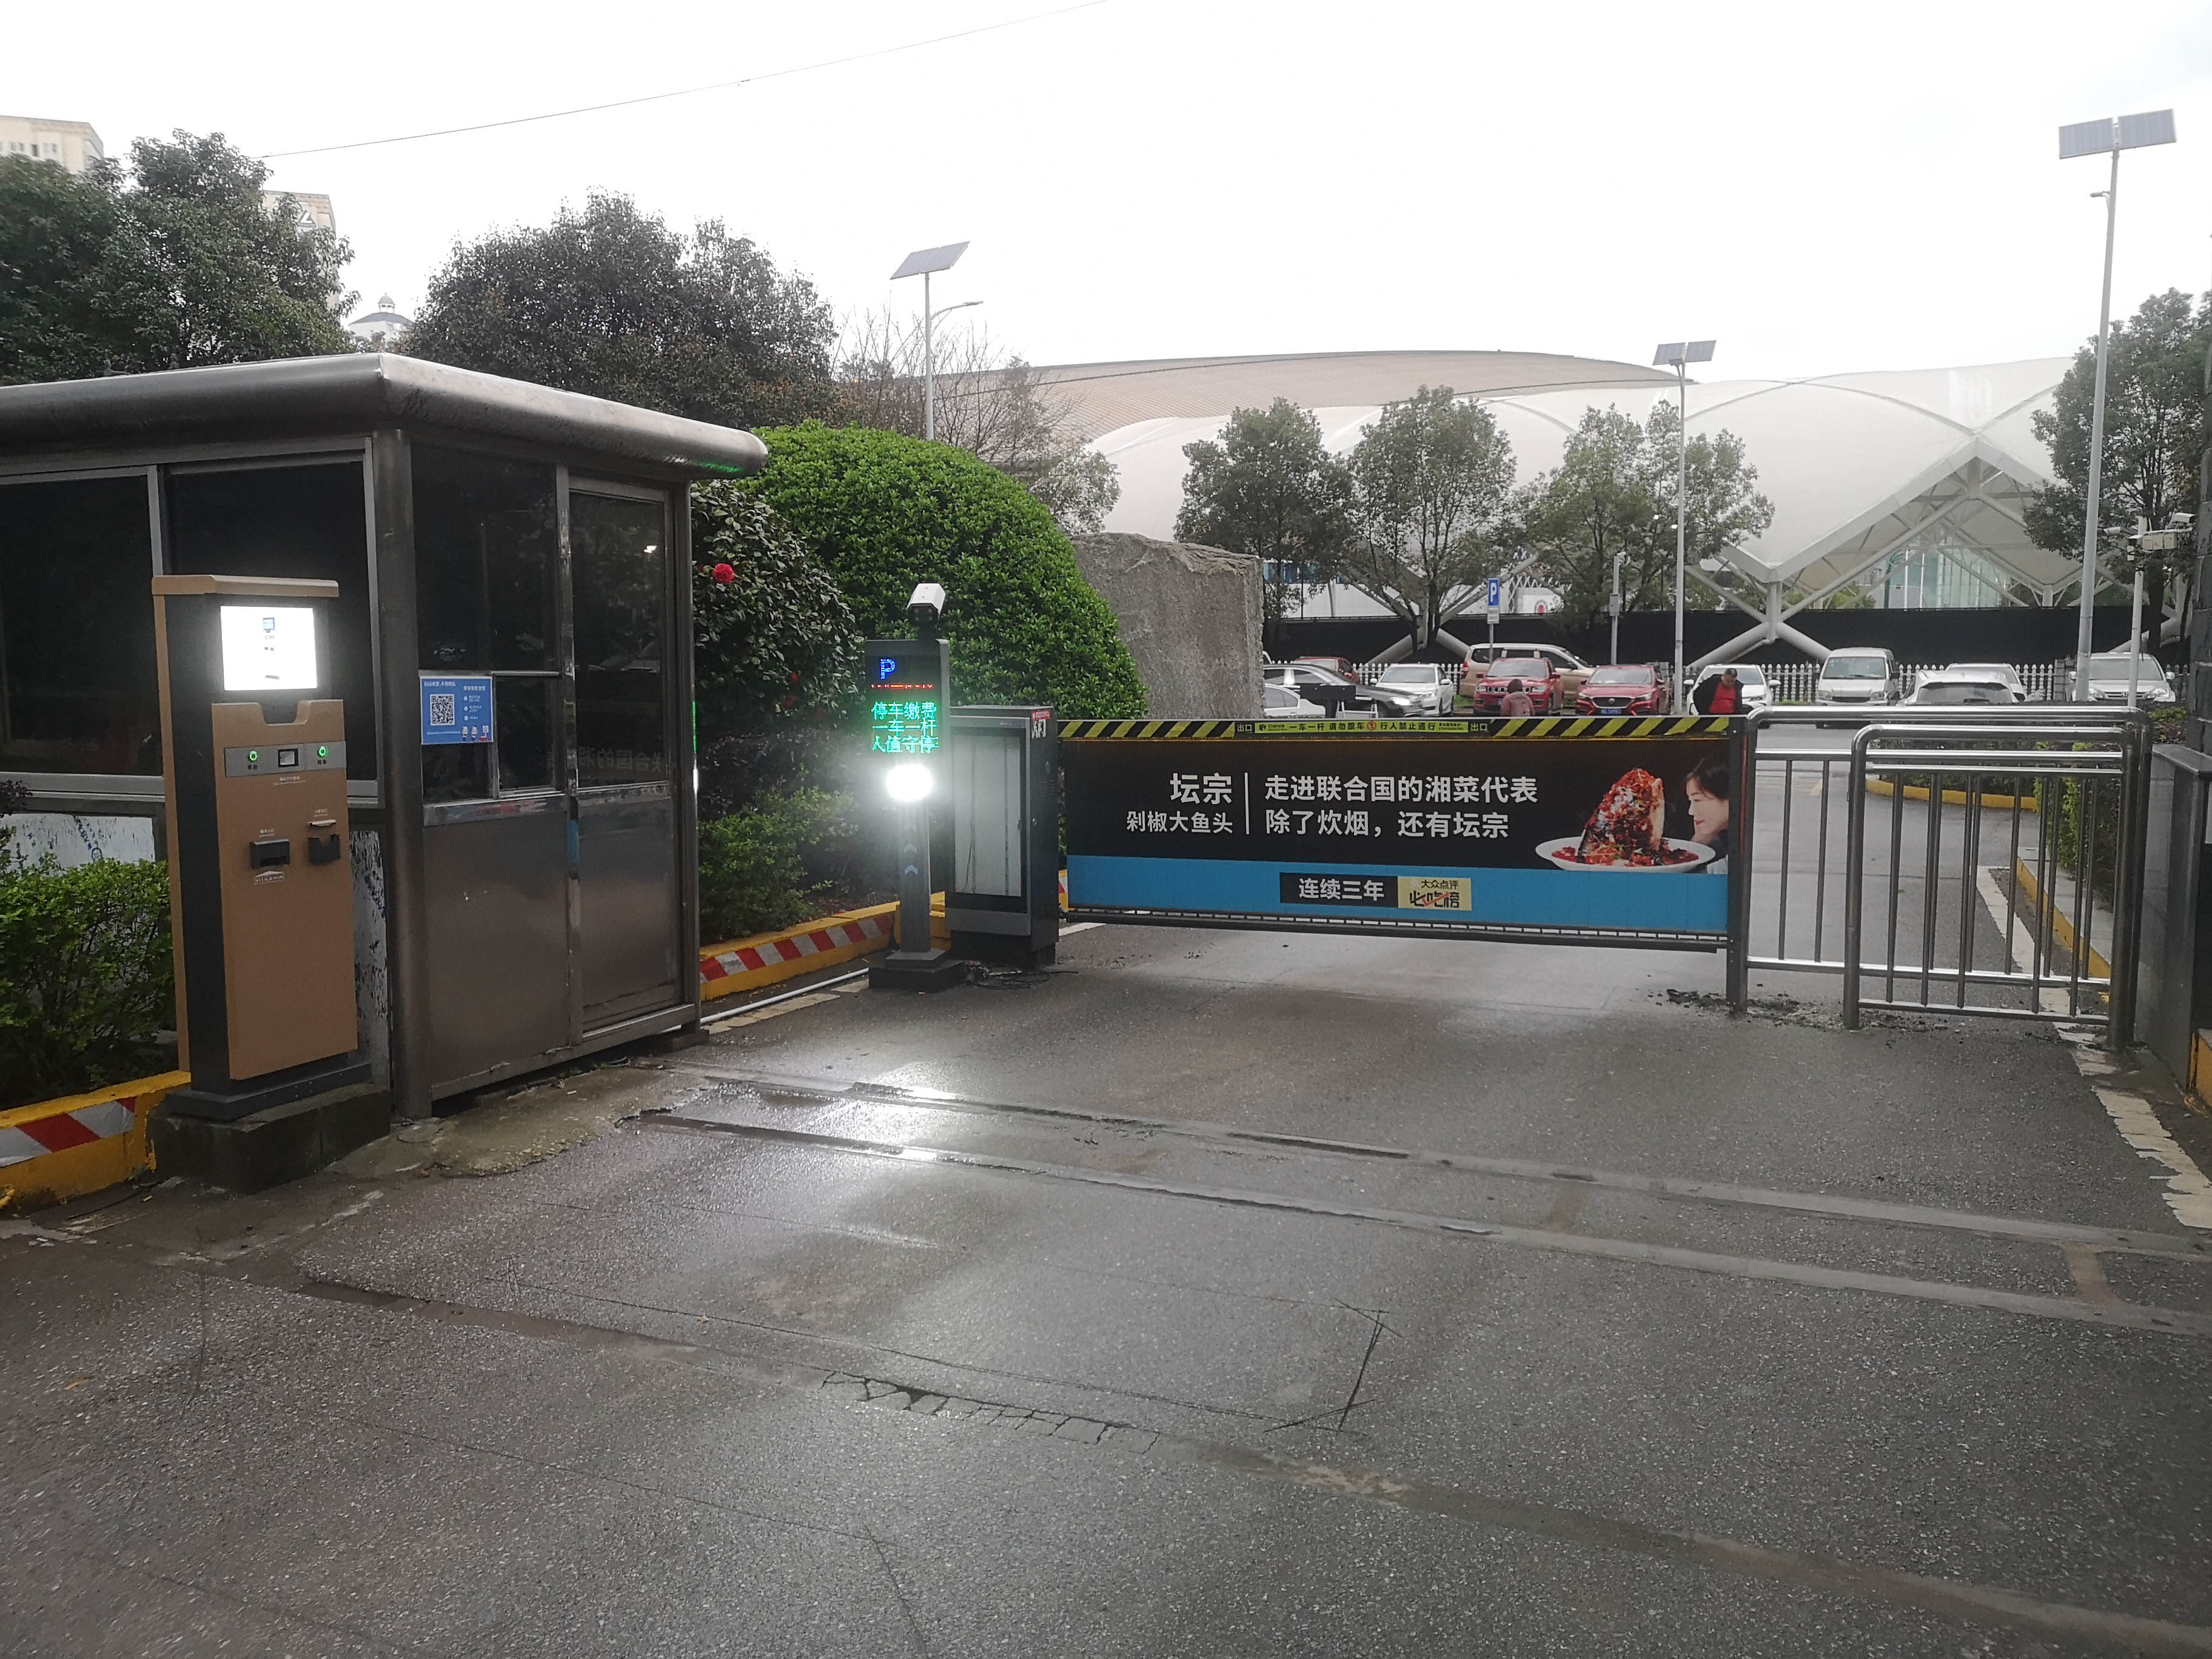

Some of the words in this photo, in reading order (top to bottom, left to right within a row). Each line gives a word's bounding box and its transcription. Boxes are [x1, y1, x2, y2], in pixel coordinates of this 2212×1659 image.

[1490, 582, 1497, 602] P
[880, 658, 896, 680] P
[871, 701, 937, 720] 停车缴费
[872, 716, 937, 737] 一车一杆
[1289, 722, 1325, 731] 一车一杆
[1380, 722, 1436, 731] 行人禁止通行
[1470, 723, 1488, 731] 出口
[1170, 773, 1232, 804] 坛宗
[1265, 774, 1538, 803] 走进联合国的湘菜代表
[1126, 811, 1233, 834] 剁椒大鱼头
[1265, 808, 1509, 839] 除了炊烟，还有坛宗
[1298, 878, 1385, 902] 连续三年
[1421, 879, 1459, 890] 大众点评
[1409, 891, 1460, 909] 必吃榜
